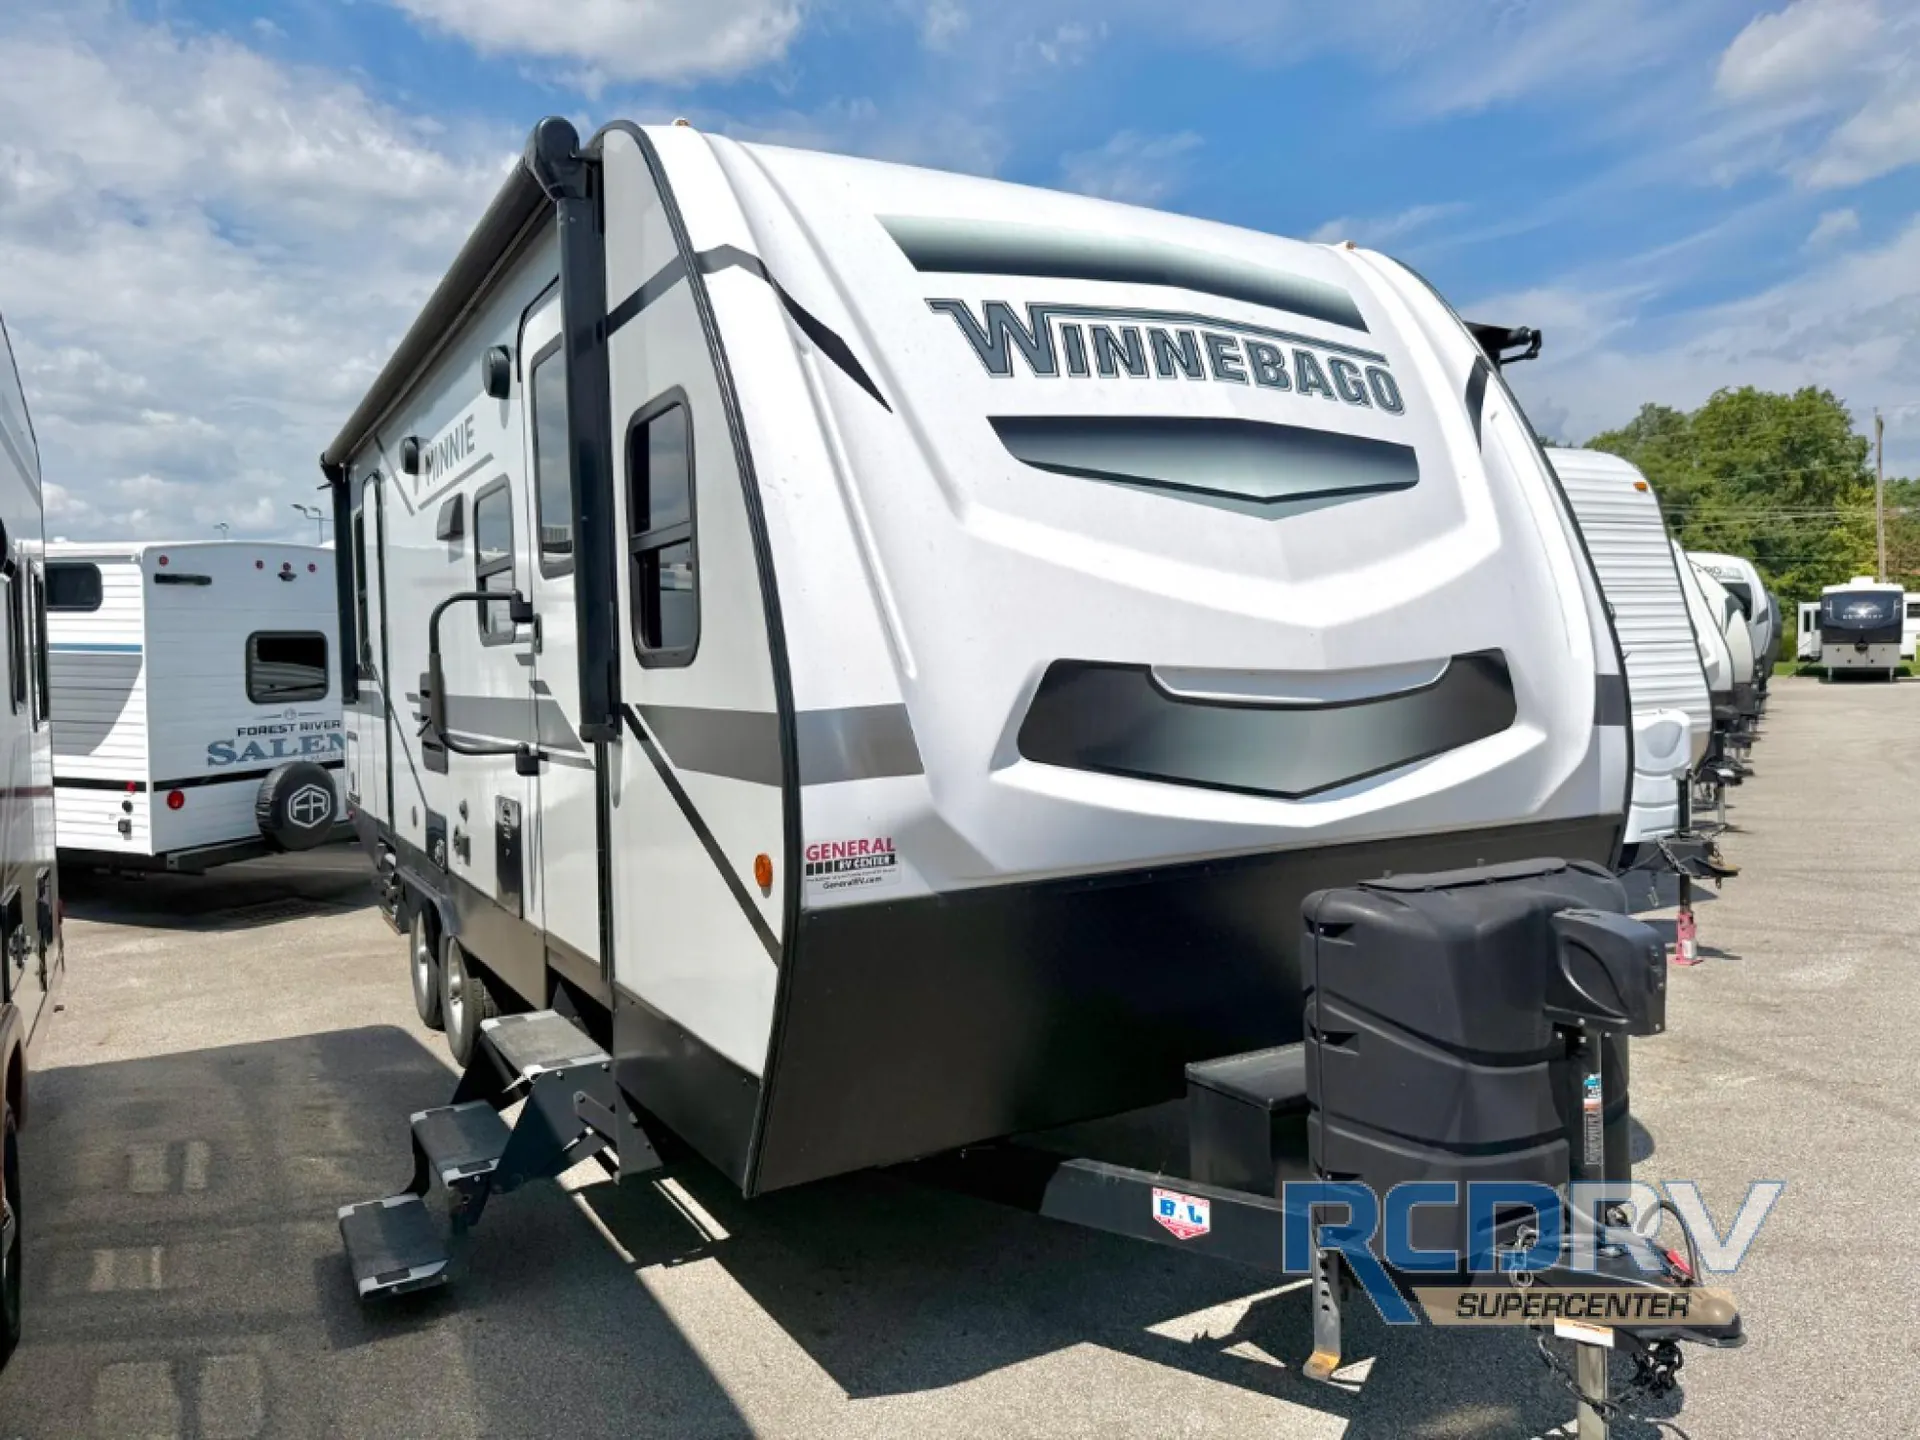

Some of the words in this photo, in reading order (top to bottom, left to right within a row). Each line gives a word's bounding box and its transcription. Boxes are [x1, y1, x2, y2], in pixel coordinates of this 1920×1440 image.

[924, 297, 1406, 416] WINNEBAGO
[237, 723, 296, 737] FOREST
[299, 720, 340, 731] RIVER
[806, 838, 895, 861] GENERAL
